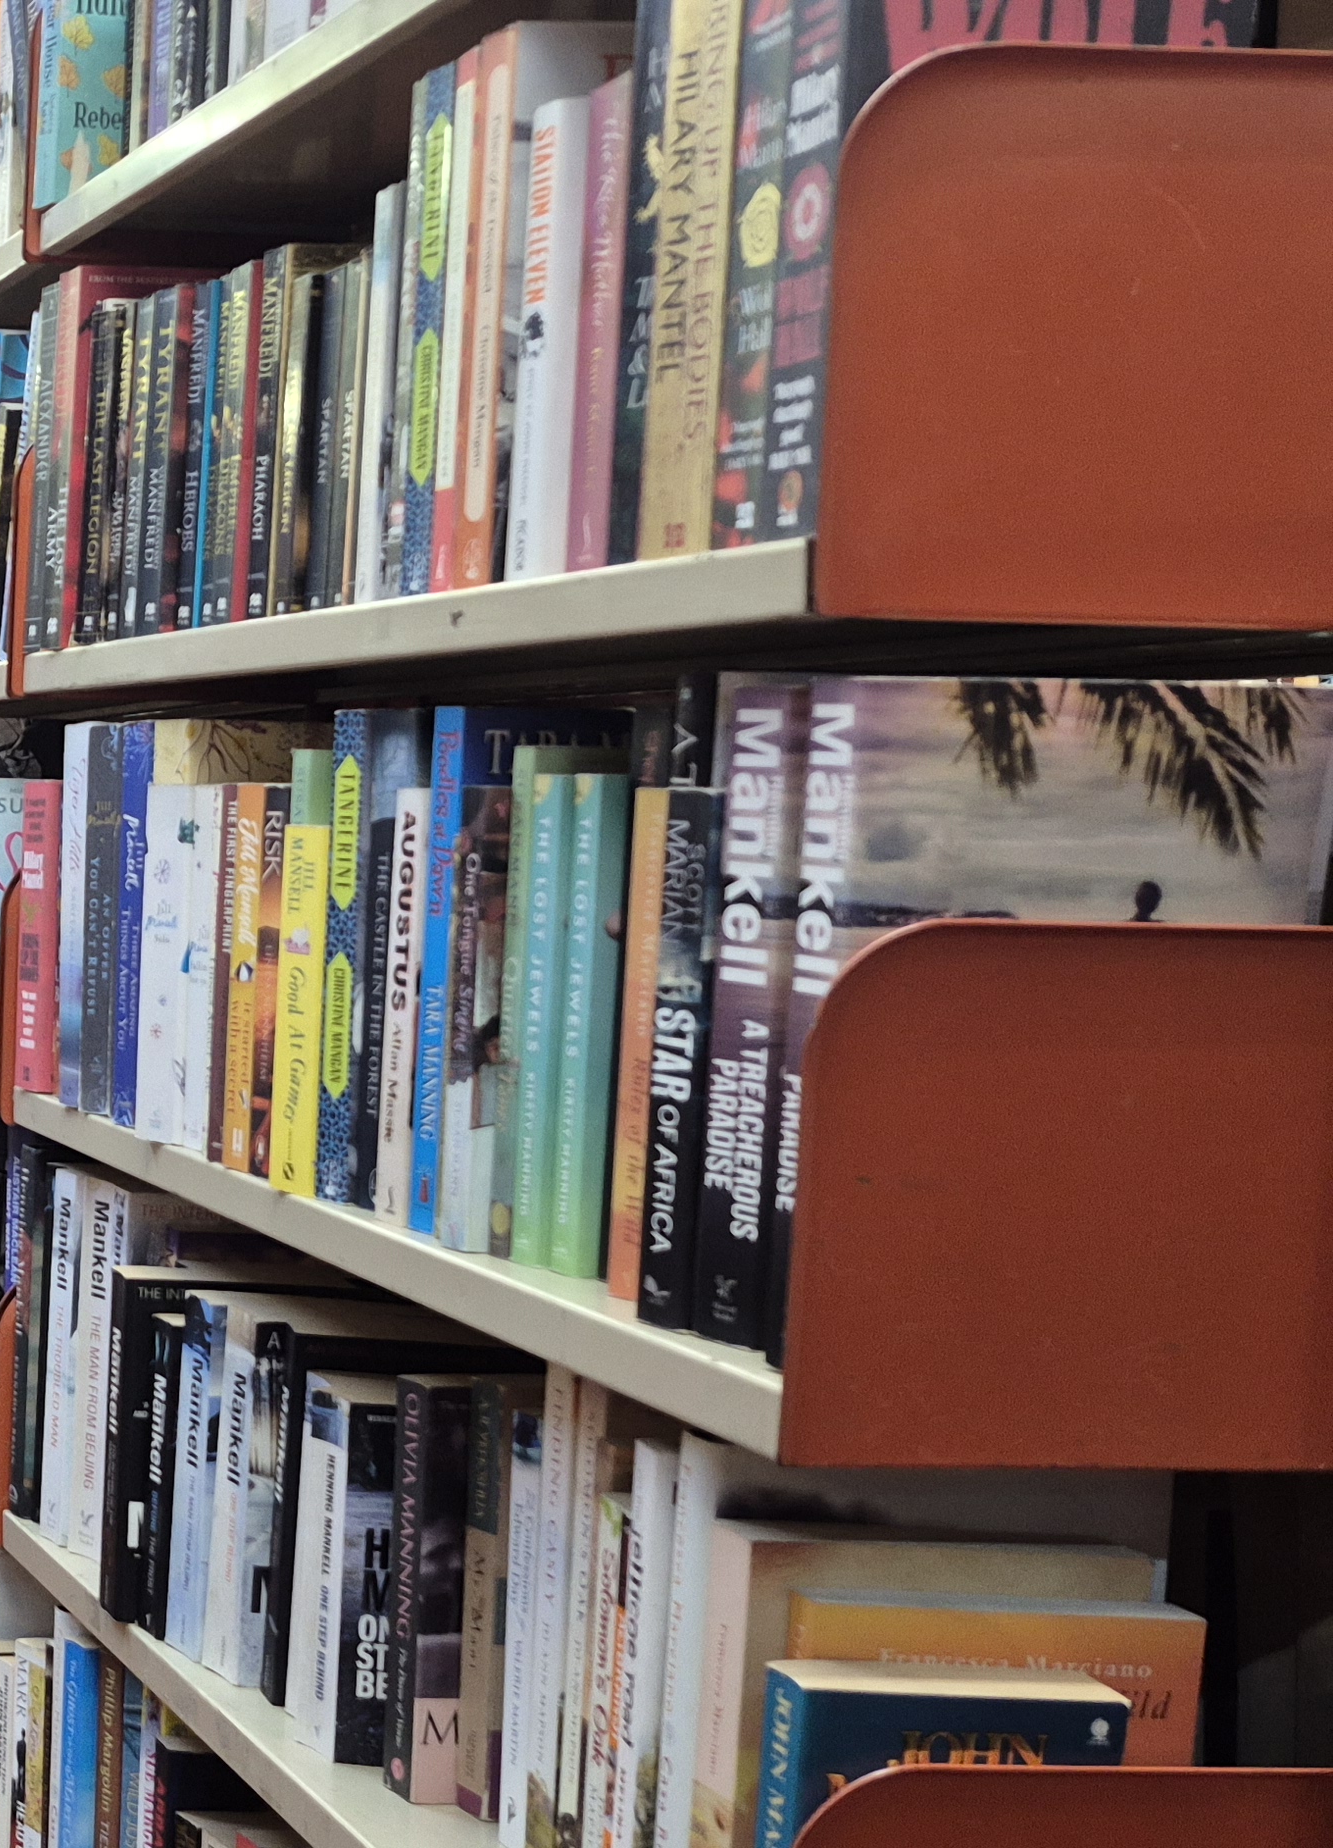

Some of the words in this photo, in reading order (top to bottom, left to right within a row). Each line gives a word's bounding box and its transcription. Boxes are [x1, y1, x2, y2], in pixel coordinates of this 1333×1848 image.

[667, 48, 701, 194] HILARY
[700, 124, 724, 178] UP
[530, 126, 558, 218] STATION
[524, 223, 551, 306] ELEVEN
[693, 198, 719, 284] THE
[227, 289, 249, 390] MANFREDI
[257, 276, 280, 380] MANFREDI
[654, 212, 691, 387] MANTEL
[153, 319, 174, 461] TYRANT
[187, 308, 206, 405] MANFREDI
[416, 343, 433, 412] CHRISTINE
[34, 379, 54, 482] ALEXANDER
[132, 330, 152, 466] TYRANT
[339, 388, 355, 479] SPARTAN
[91, 437, 105, 486] LAST
[317, 397, 332, 484] SPARTAN
[414, 415, 432, 472] MANGAN
[85, 490, 103, 574] LEGION
[123, 475, 139, 577] MANFREDI
[143, 467, 160, 570] MANFREDI
[181, 469, 199, 552] HEROES
[213, 458, 230, 556] DRAGONS
[251, 454, 271, 541] PHARAOH
[44, 506, 59, 573] ARMY
[224, 826, 237, 863] FIRST
[237, 817, 259, 861] Jill
[262, 809, 286, 881] RISK
[334, 772, 359, 891] TANGERINE
[376, 851, 390, 893] THE
[535, 815, 553, 864] THE
[576, 816, 594, 867] THE
[718, 705, 784, 989] Mankell
[790, 702, 854, 998] Mankell
[220, 867, 235, 956] FINGERPRINT
[287, 836, 305, 916] MANSELL
[301, 860, 315, 892] JILL
[390, 811, 417, 1013] AUGUSTUS
[462, 852, 482, 898] One
[530, 875, 548, 942] LOST
[571, 877, 590, 946] LOST
[118, 905, 132, 964] THINGS
[373, 895, 388, 960] CASTLE
[457, 902, 477, 975] Tongue
[287, 966, 307, 1016] Good
[330, 967, 347, 1028] CHRISTINE
[369, 993, 383, 1034] THE
[422, 986, 444, 1039] TARA
[524, 952, 543, 1053] JEWELS
[564, 957, 585, 1059] JEWELS
[741, 1018, 769, 1040] A
[287, 1024, 307, 1054] At
[328, 1030, 344, 1084] MANGAN
[365, 1038, 381, 1120] FOREST
[389, 1021, 406, 1075] Allan
[649, 1006, 697, 1103] STAR
[282, 1058, 305, 1126] Games
[381, 1078, 401, 1144] Massie
[417, 1044, 440, 1141] MANNING
[656, 1104, 680, 1139] OF
[703, 1056, 737, 1193] PARADISE
[556, 1141, 572, 1227] MANNING
[729, 1047, 769, 1243] TREACHEROUS
[648, 1141, 677, 1254] AFRICA
[55, 1196, 73, 1292] Mankell
[89, 1199, 111, 1300] Mankell
[50, 1336, 65, 1412] TROUBLED
[87, 1346, 101, 1381] MAN
[108, 1326, 122, 1436] Mankell
[85, 1384, 99, 1429] FROM
[148, 1372, 168, 1486] Mankell
[185, 1357, 205, 1470] Mankell
[226, 1371, 248, 1487] Mankell
[273, 1385, 291, 1504] Mankell
[401, 1393, 419, 1485] OLIVIA
[81, 1432, 97, 1491] BEIJING
[323, 1454, 337, 1513] HENNING
[545, 1387, 564, 1509] FINDING
[320, 1516, 333, 1577] MANKELL
[395, 1493, 417, 1640] MANNING
[543, 1518, 557, 1610] CASEY
[317, 1614, 329, 1648] STEP
[593, 1547, 617, 1695] Solomon's
[623, 1528, 645, 1662] jellicoe
[16, 1655, 28, 1719] MARK
[103, 1666, 117, 1728] Phillip
[314, 1650, 327, 1701] BEHIND
[1027, 1655, 1153, 1680] Marciano
[590, 1703, 610, 1768] Oak
[619, 1672, 638, 1750] road
[902, 1731, 1049, 1766] JOHN
[100, 1731, 114, 1813] Margolin
[126, 1771, 140, 1817] WILD
